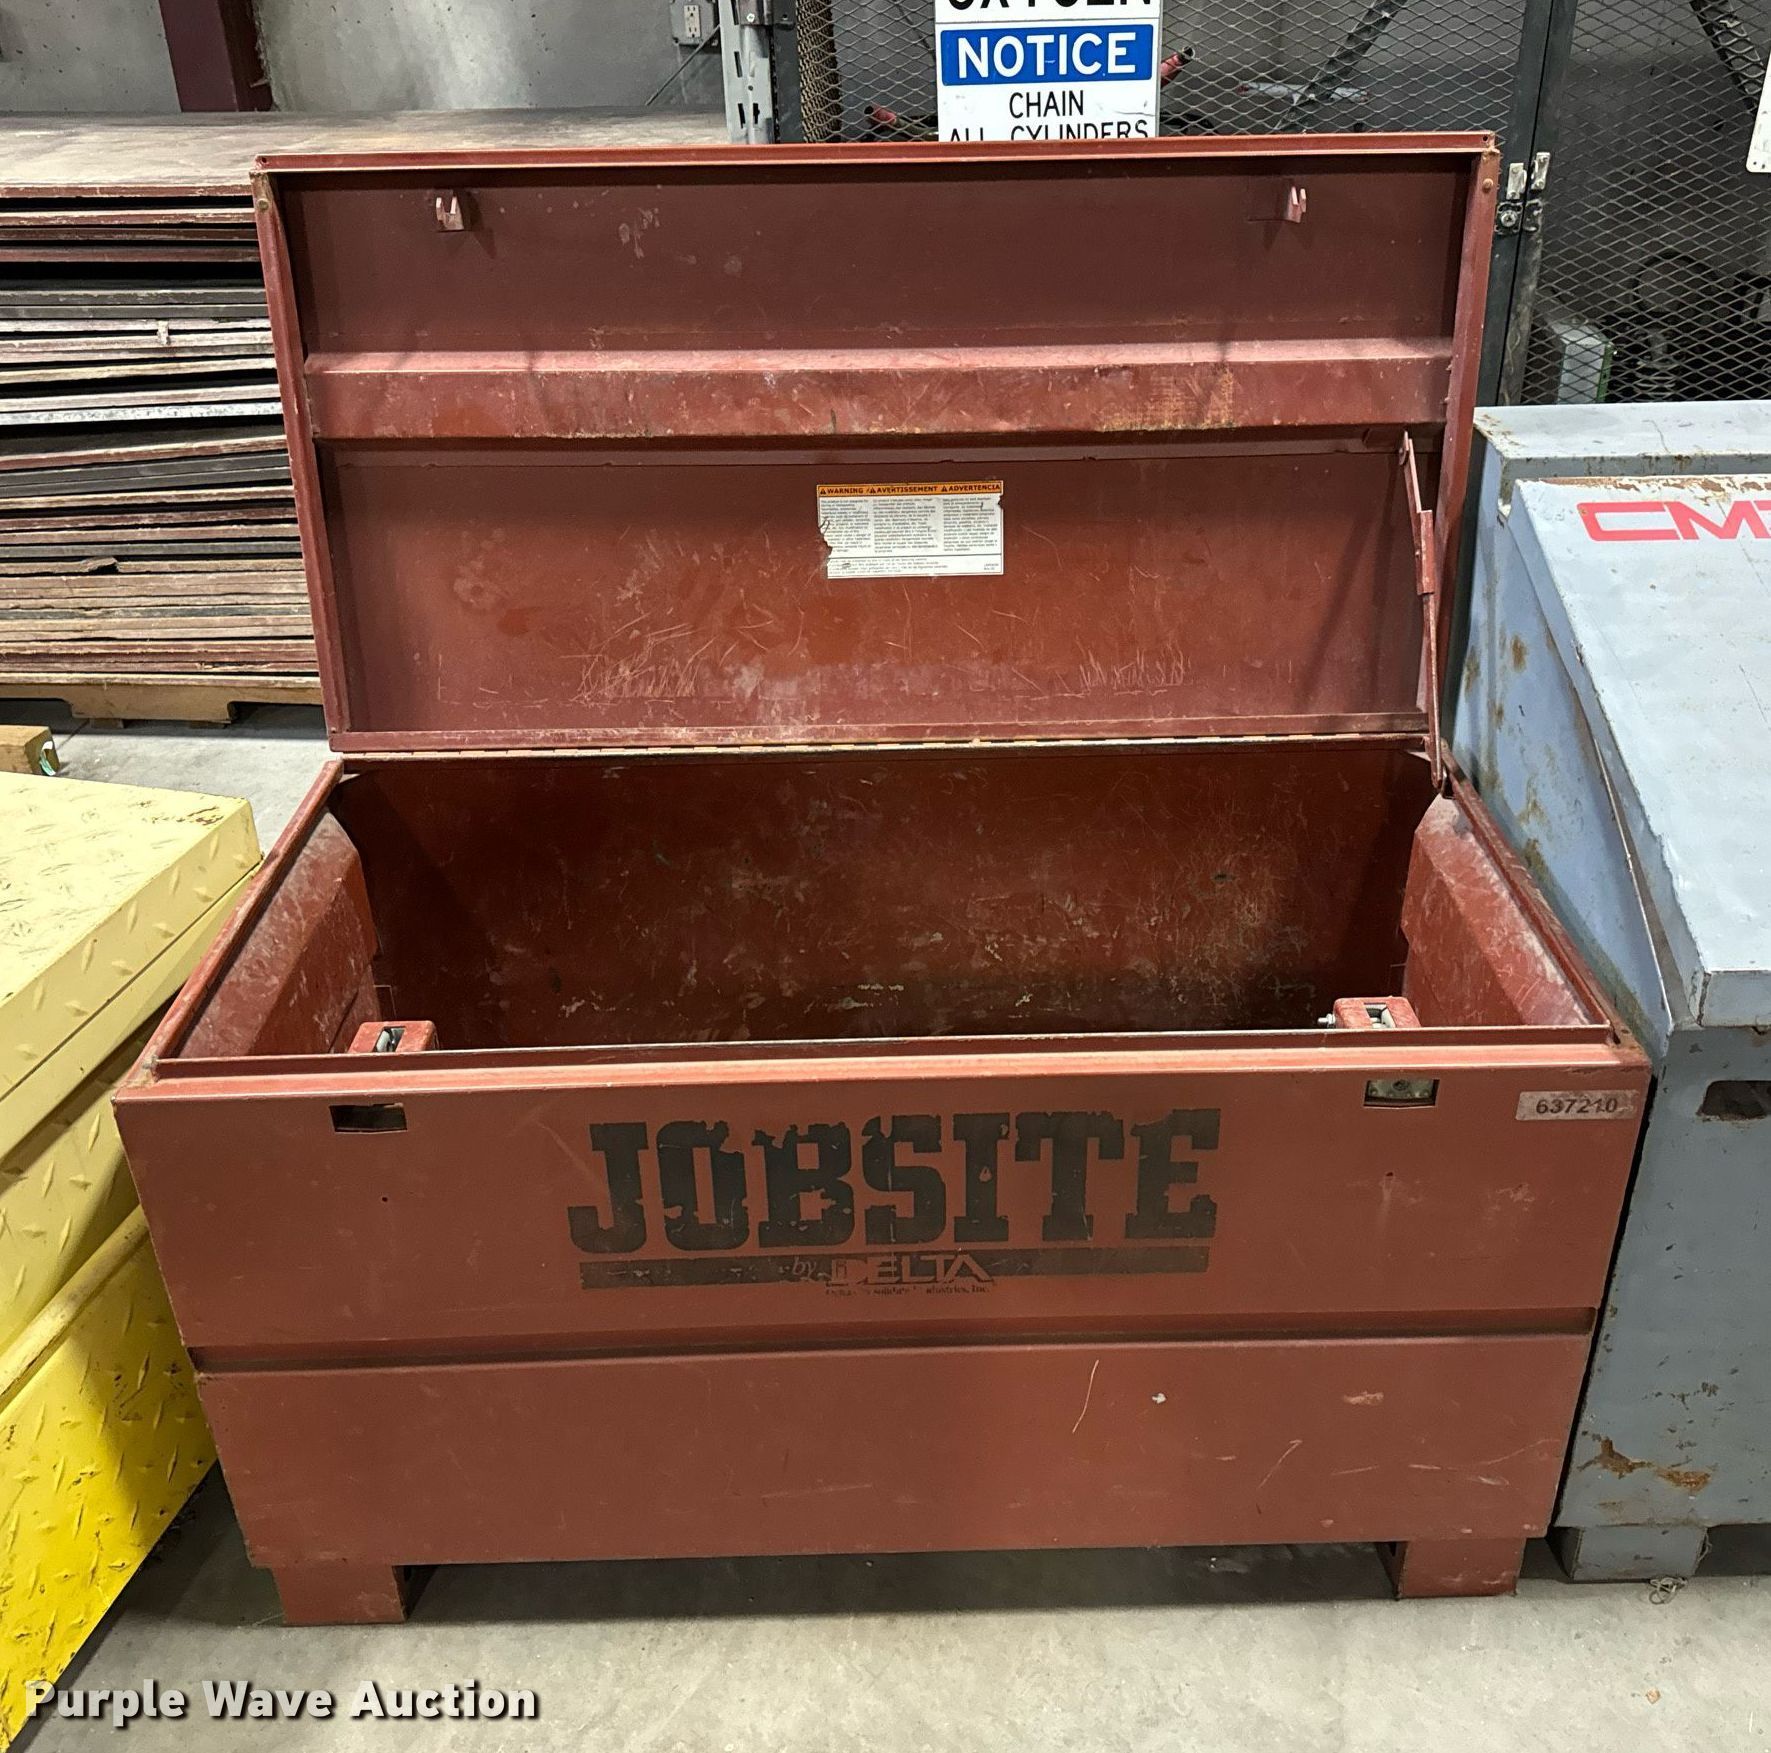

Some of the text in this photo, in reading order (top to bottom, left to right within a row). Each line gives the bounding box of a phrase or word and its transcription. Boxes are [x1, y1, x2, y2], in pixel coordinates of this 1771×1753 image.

[957, 32, 1137, 79] NOTICE
[1009, 90, 1084, 119] CHAIN
[877, 486, 937, 494] AVERTISSEMENT
[948, 484, 1001, 492] ADVERTENCIA
[1576, 500, 1771, 542] CM
[1535, 1097, 1618, 1115] 637210
[568, 1108, 1221, 1254] JOBSITE
[792, 1253, 993, 1285] by DELTA
